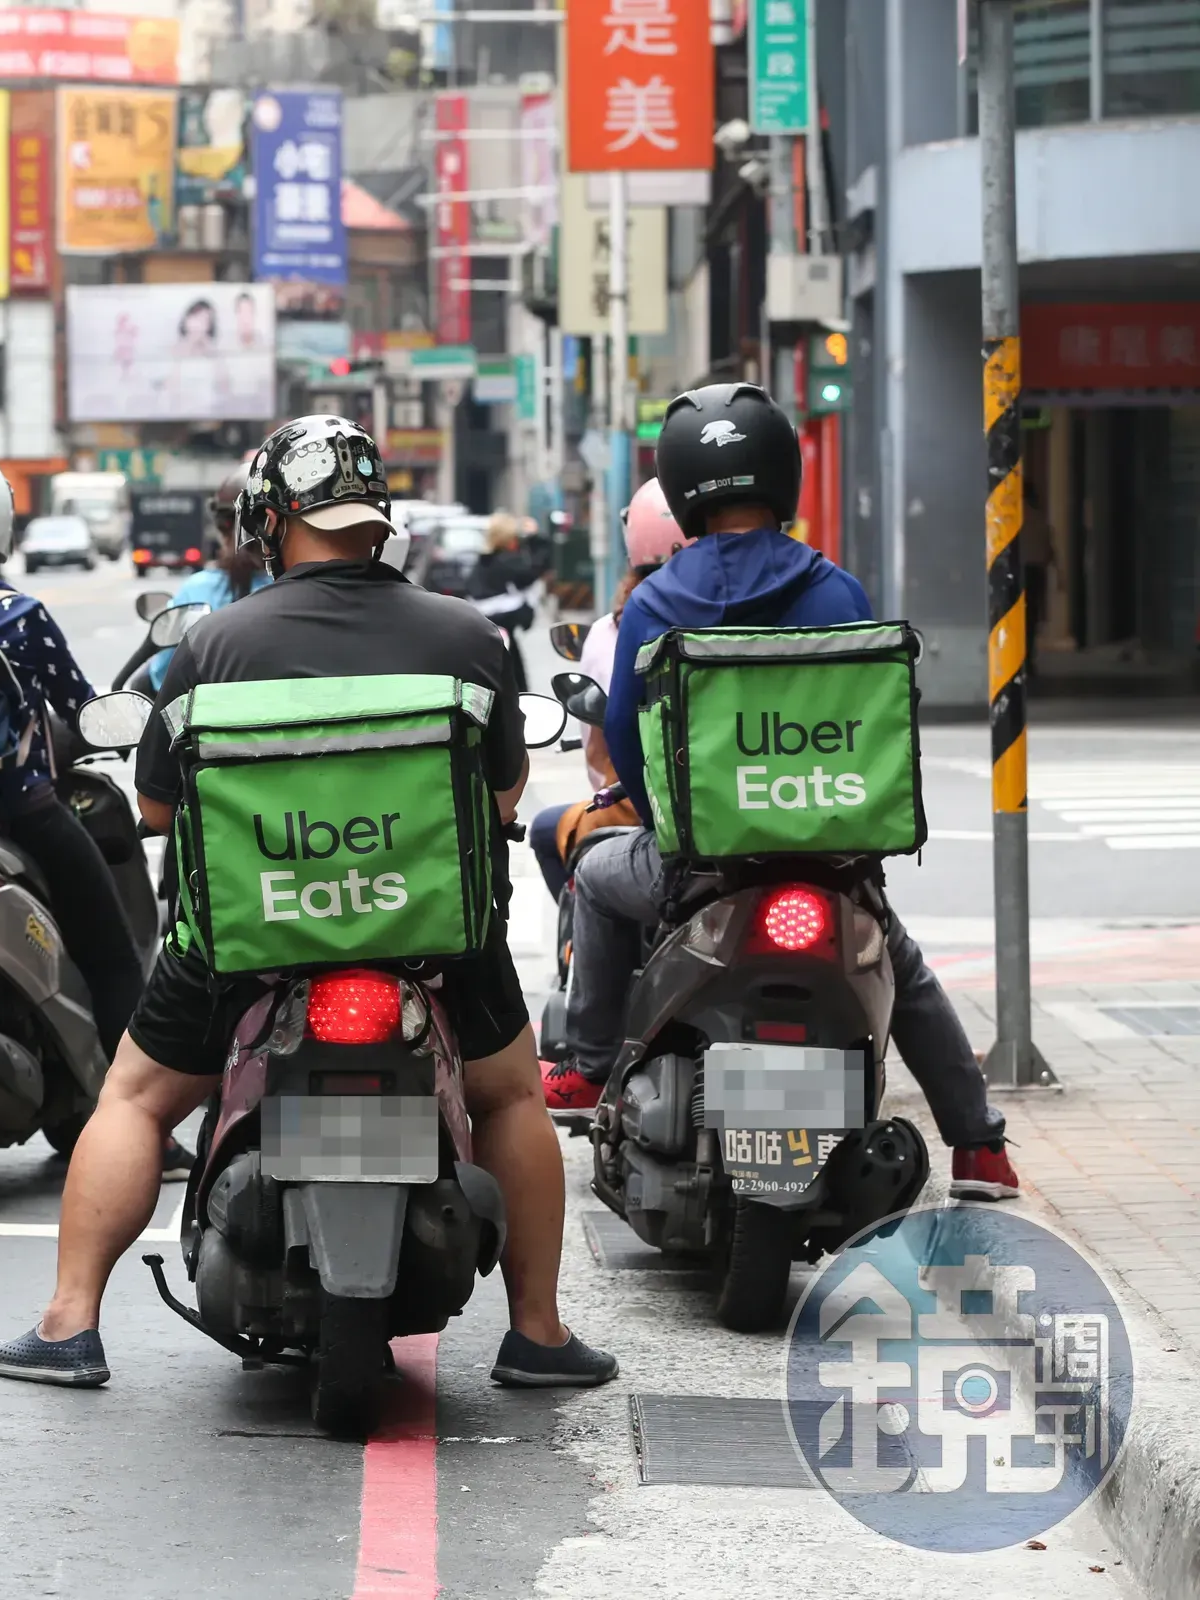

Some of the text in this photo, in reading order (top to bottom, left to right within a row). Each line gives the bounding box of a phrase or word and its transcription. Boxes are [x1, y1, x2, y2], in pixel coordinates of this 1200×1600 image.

[602, 0, 678, 152] 是美
[736, 712, 862, 756] Uber
[736, 765, 867, 810] Eats
[253, 810, 400, 861] Uber
[260, 868, 408, 921] Eats
